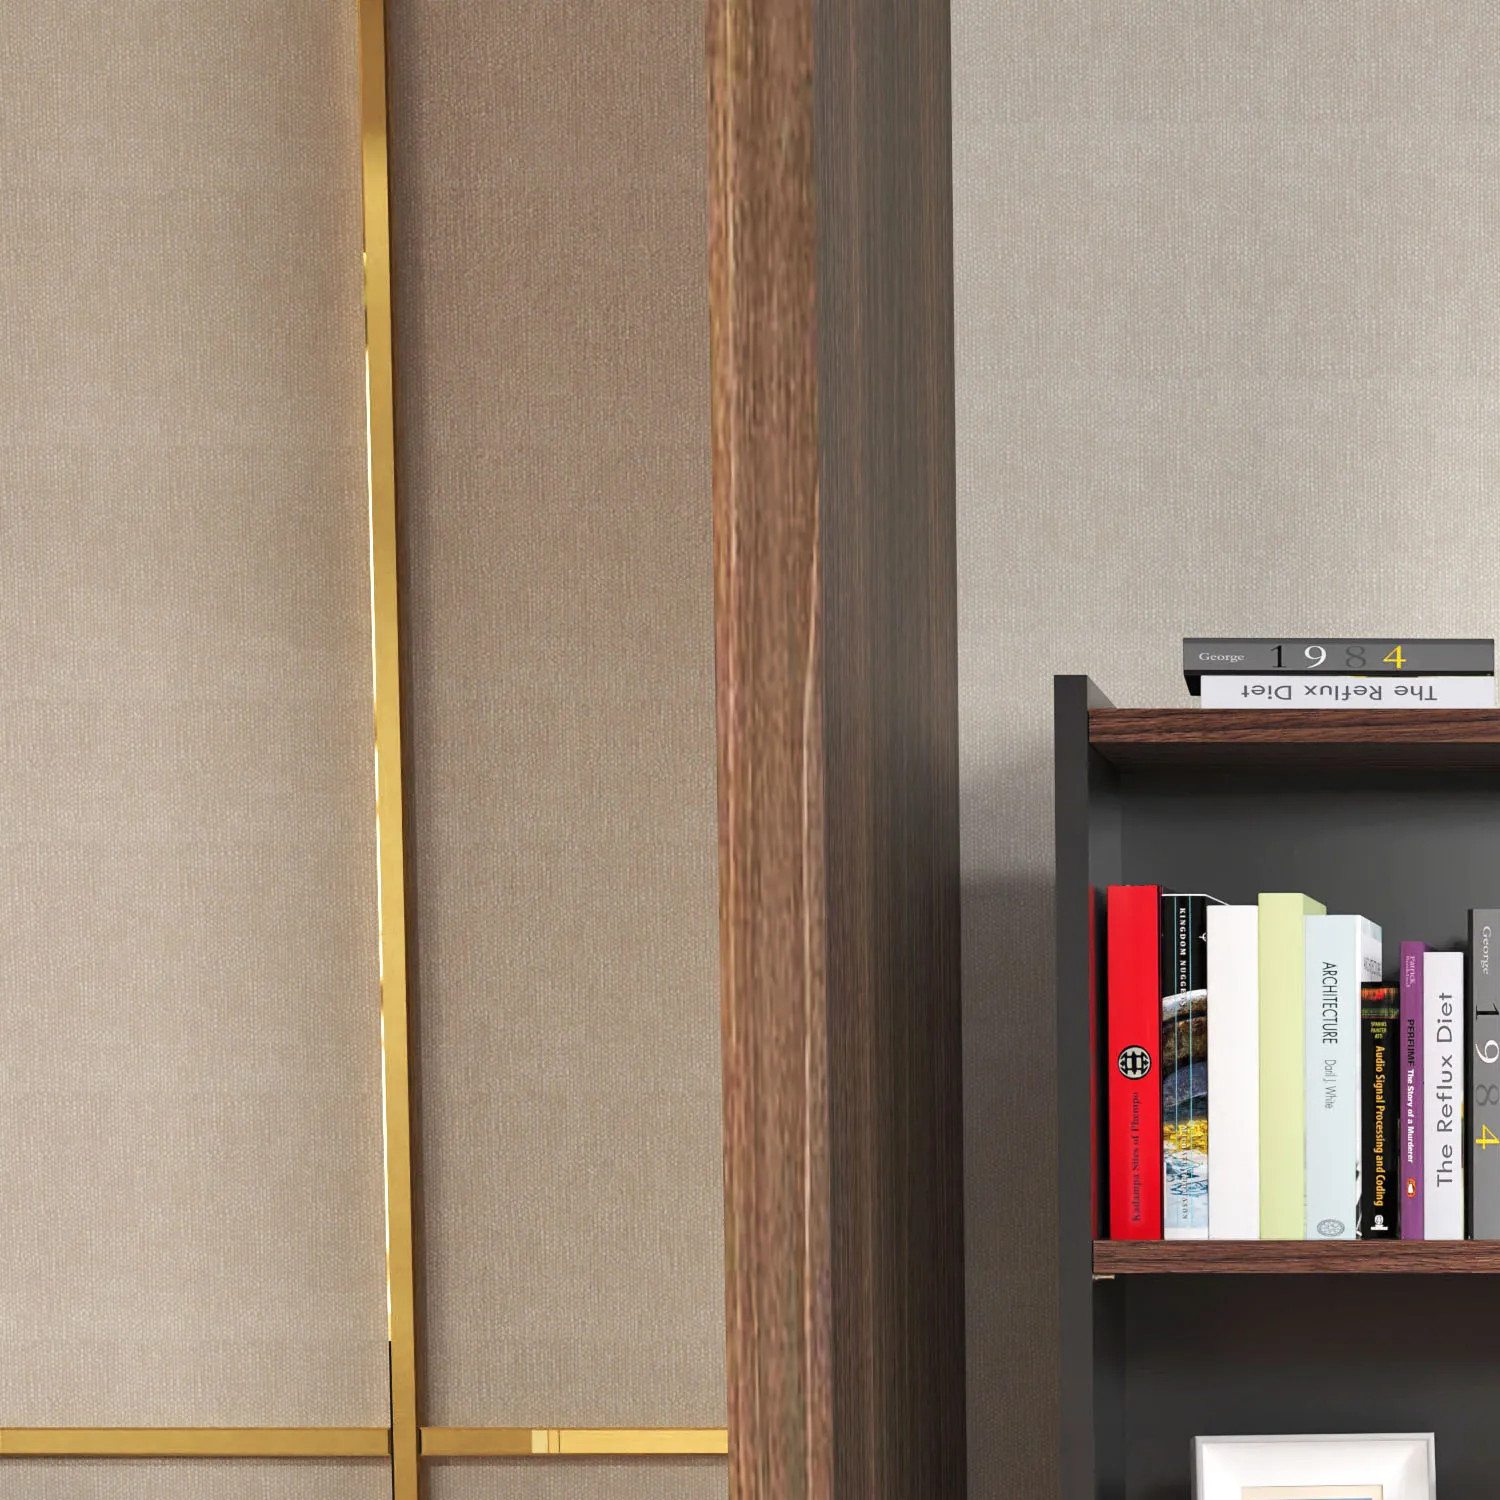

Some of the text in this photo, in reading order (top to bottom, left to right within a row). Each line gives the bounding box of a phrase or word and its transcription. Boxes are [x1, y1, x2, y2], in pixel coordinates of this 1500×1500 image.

[1199, 652, 1245, 662] George
[1241, 685, 1438, 701] The Reflux Diet
[1481, 926, 1491, 974] George
[1323, 962, 1337, 1044] ARCHITECTURE
[1325, 1086, 1337, 1109] White
[1406, 1086, 1414, 1106] Story
[1437, 993, 1453, 1187] The Reflux Diet
[1407, 1109, 1414, 1118] of
[1373, 1046, 1385, 1206] Audio Signal Processing and Coding
[1131, 1136, 1140, 1145] of
